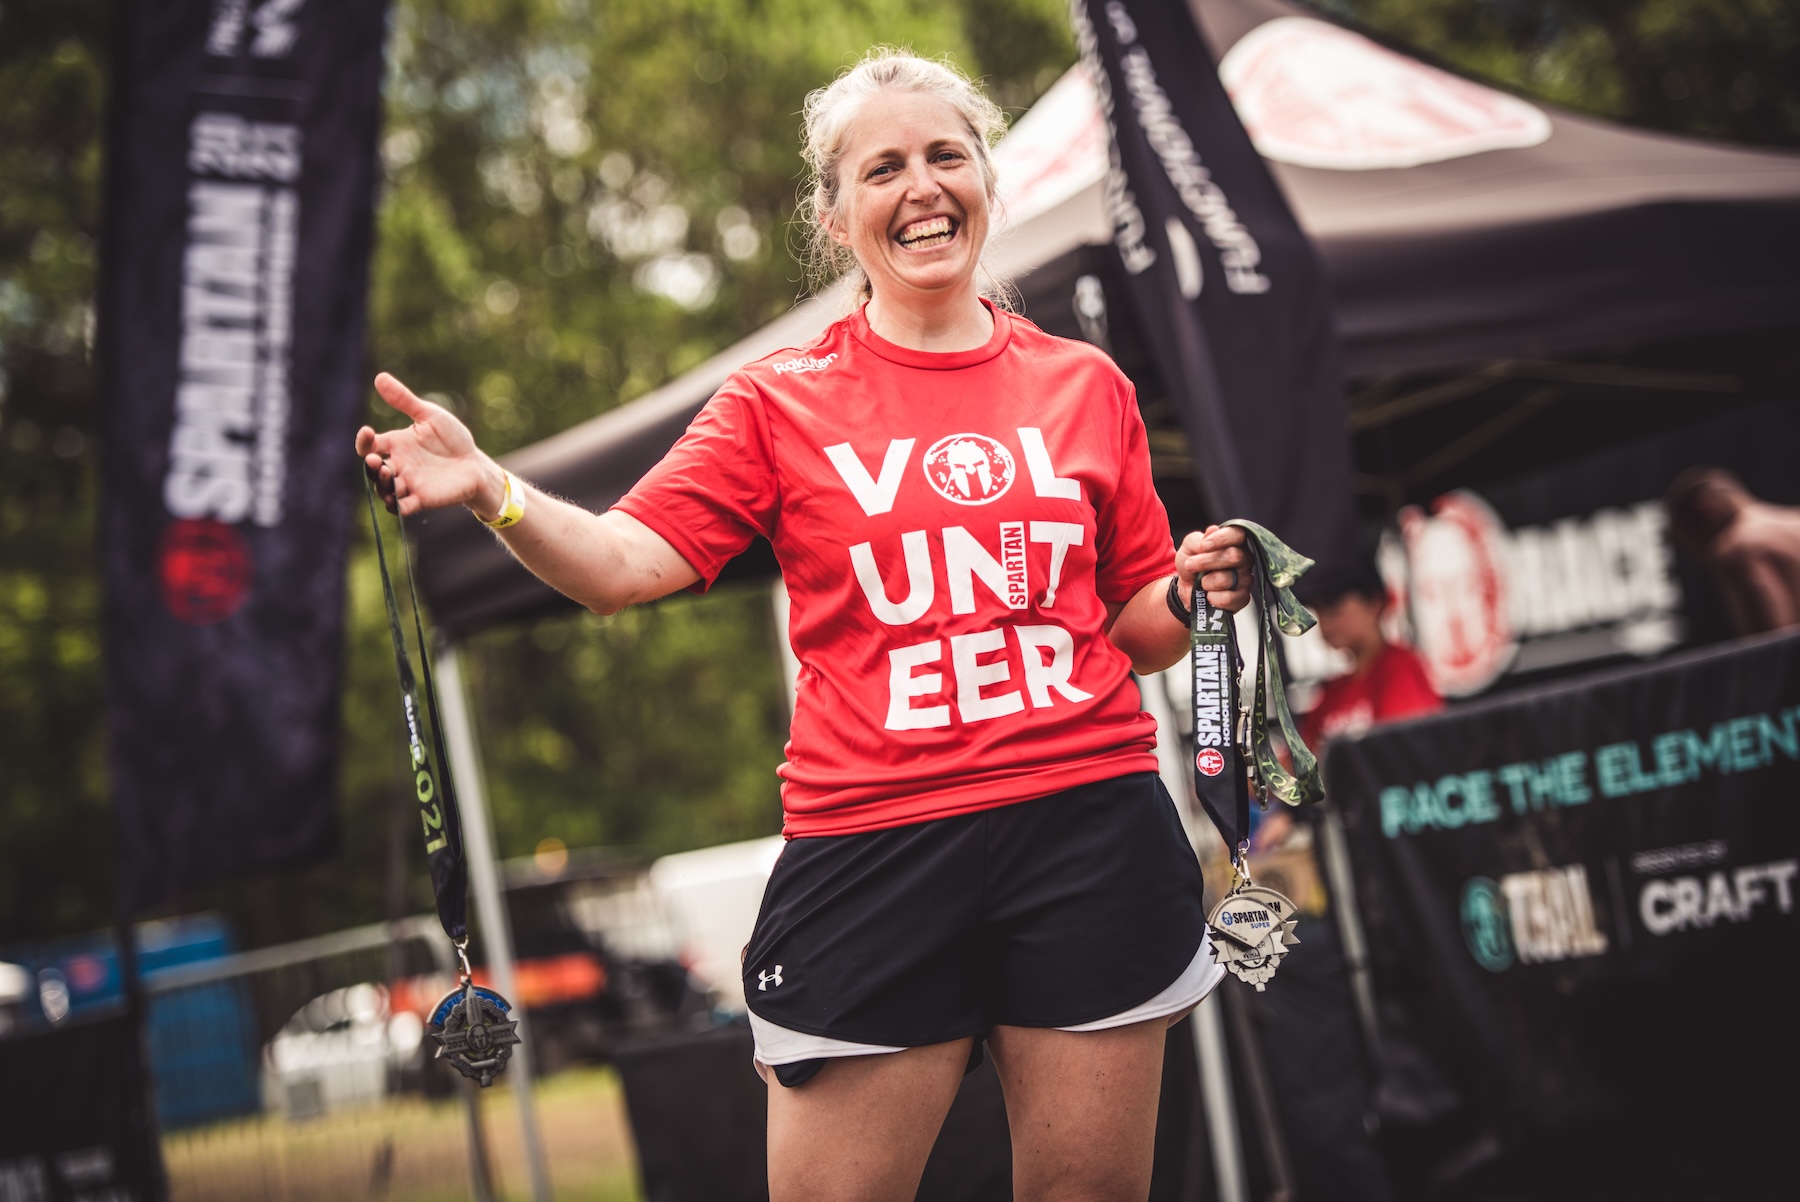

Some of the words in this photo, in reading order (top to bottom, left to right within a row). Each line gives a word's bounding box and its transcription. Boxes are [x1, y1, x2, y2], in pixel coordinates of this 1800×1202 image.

[164, 182, 261, 521] SPARTAN
[771, 352, 839, 375] Rakuten
[1001, 525, 1027, 606] SPARTAN
[1196, 598, 1207, 632] PRESENTED
[884, 624, 1095, 731] EER
[1196, 651, 1222, 747] SPARTAN
[1219, 652, 1229, 699] SERIES
[404, 694, 421, 761] SUPER
[1221, 700, 1231, 747] HONOR
[409, 738, 448, 855] 2021
[1380, 770, 1499, 838] RACE
[1499, 751, 1592, 815] THE
[1597, 706, 1800, 798] ELEMEN
[1233, 910, 1269, 924] SPARTAN
[1640, 860, 1798, 935] CRAFT
